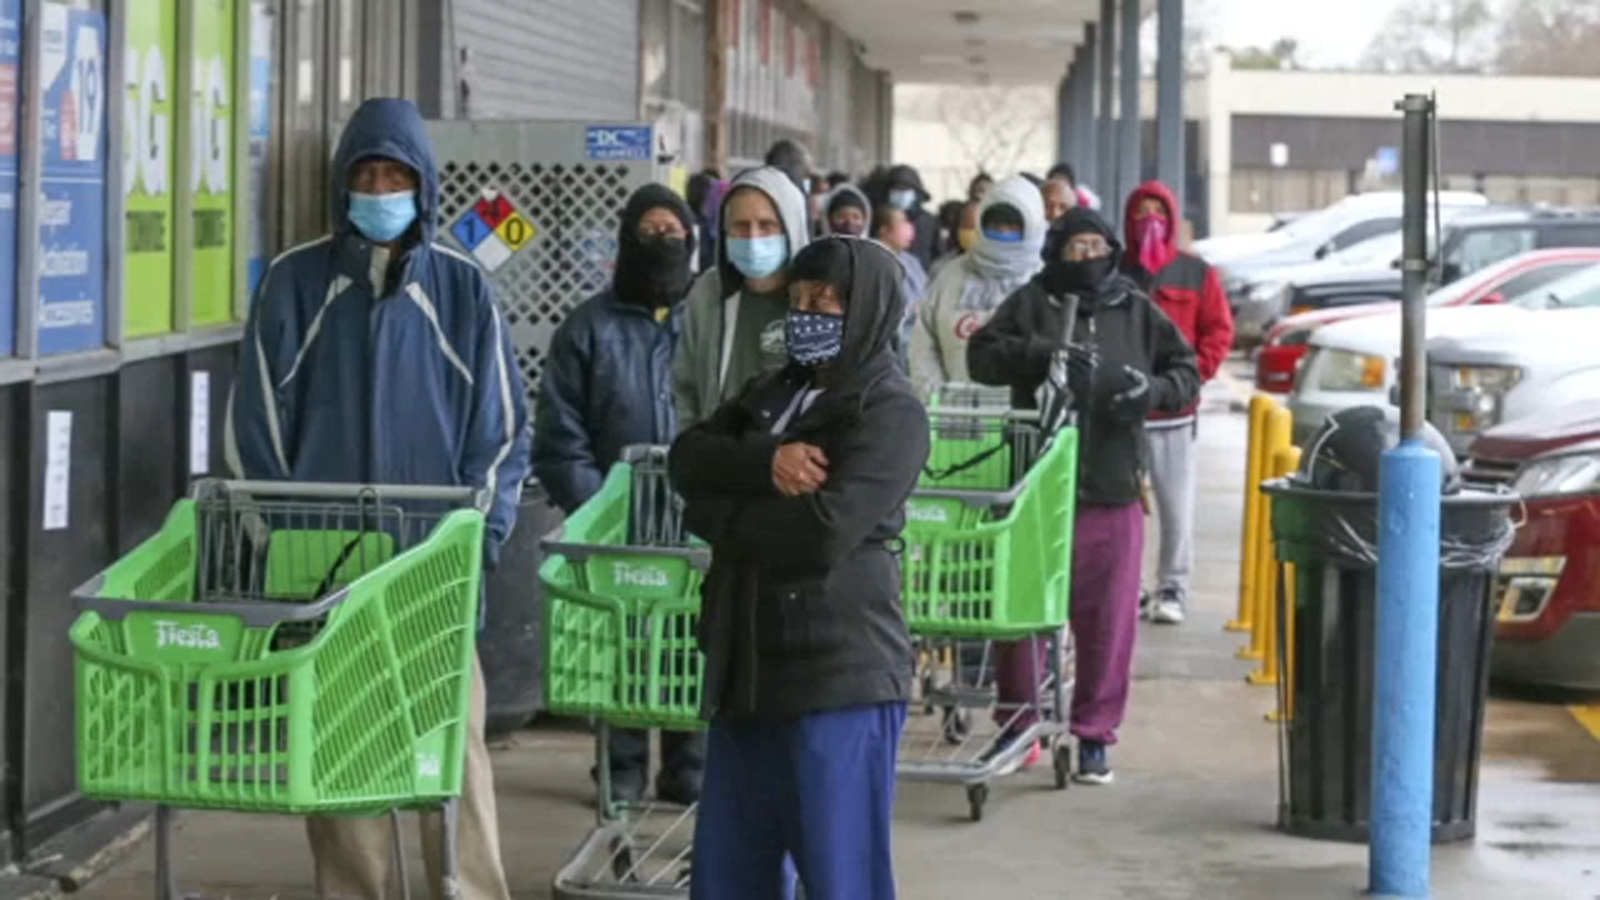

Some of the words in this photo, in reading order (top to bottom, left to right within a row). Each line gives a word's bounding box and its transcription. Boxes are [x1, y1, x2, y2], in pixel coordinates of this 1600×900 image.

[464, 217, 475, 243] 1
[505, 216, 524, 245] 0
[612, 561, 669, 586] Fiesta
[153, 619, 220, 648] Fiesta
